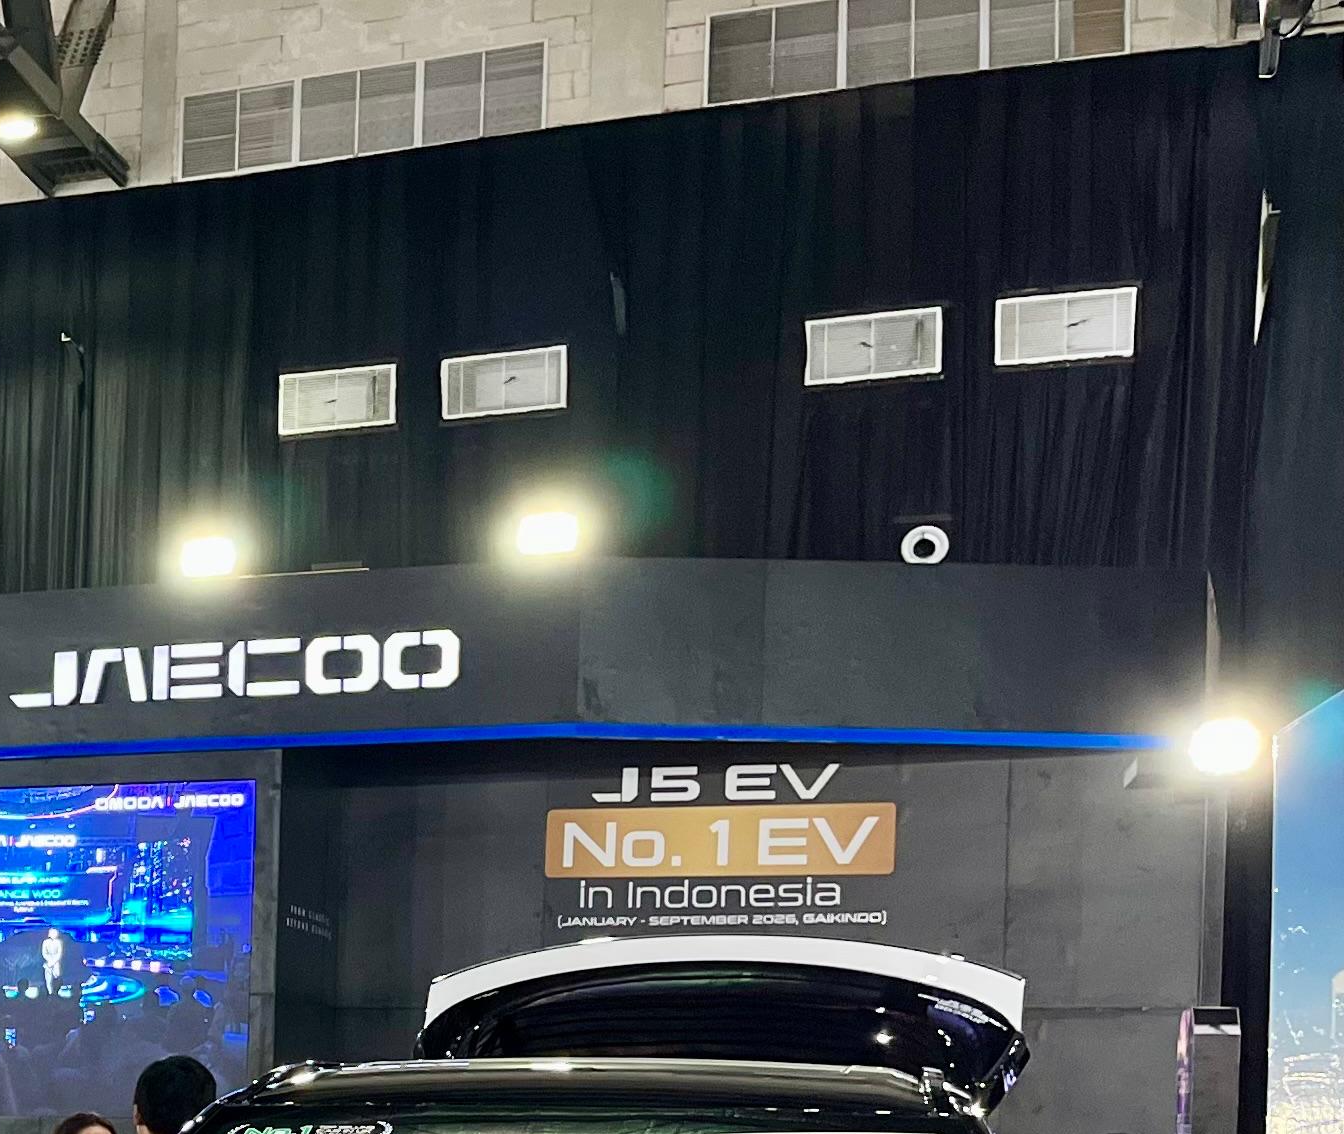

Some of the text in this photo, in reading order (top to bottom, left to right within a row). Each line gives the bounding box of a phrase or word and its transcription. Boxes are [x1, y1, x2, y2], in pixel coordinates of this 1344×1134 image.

[9, 629, 461, 708] JAECOO
[591, 763, 840, 803] J5 EV
[95, 793, 245, 811] OMODA JAECOO
[562, 816, 880, 868] No. 1 EV
[32, 889, 61, 898] WOO
[579, 877, 841, 909] in Indonesia
[649, 914, 749, 926] SEPTEMBER
